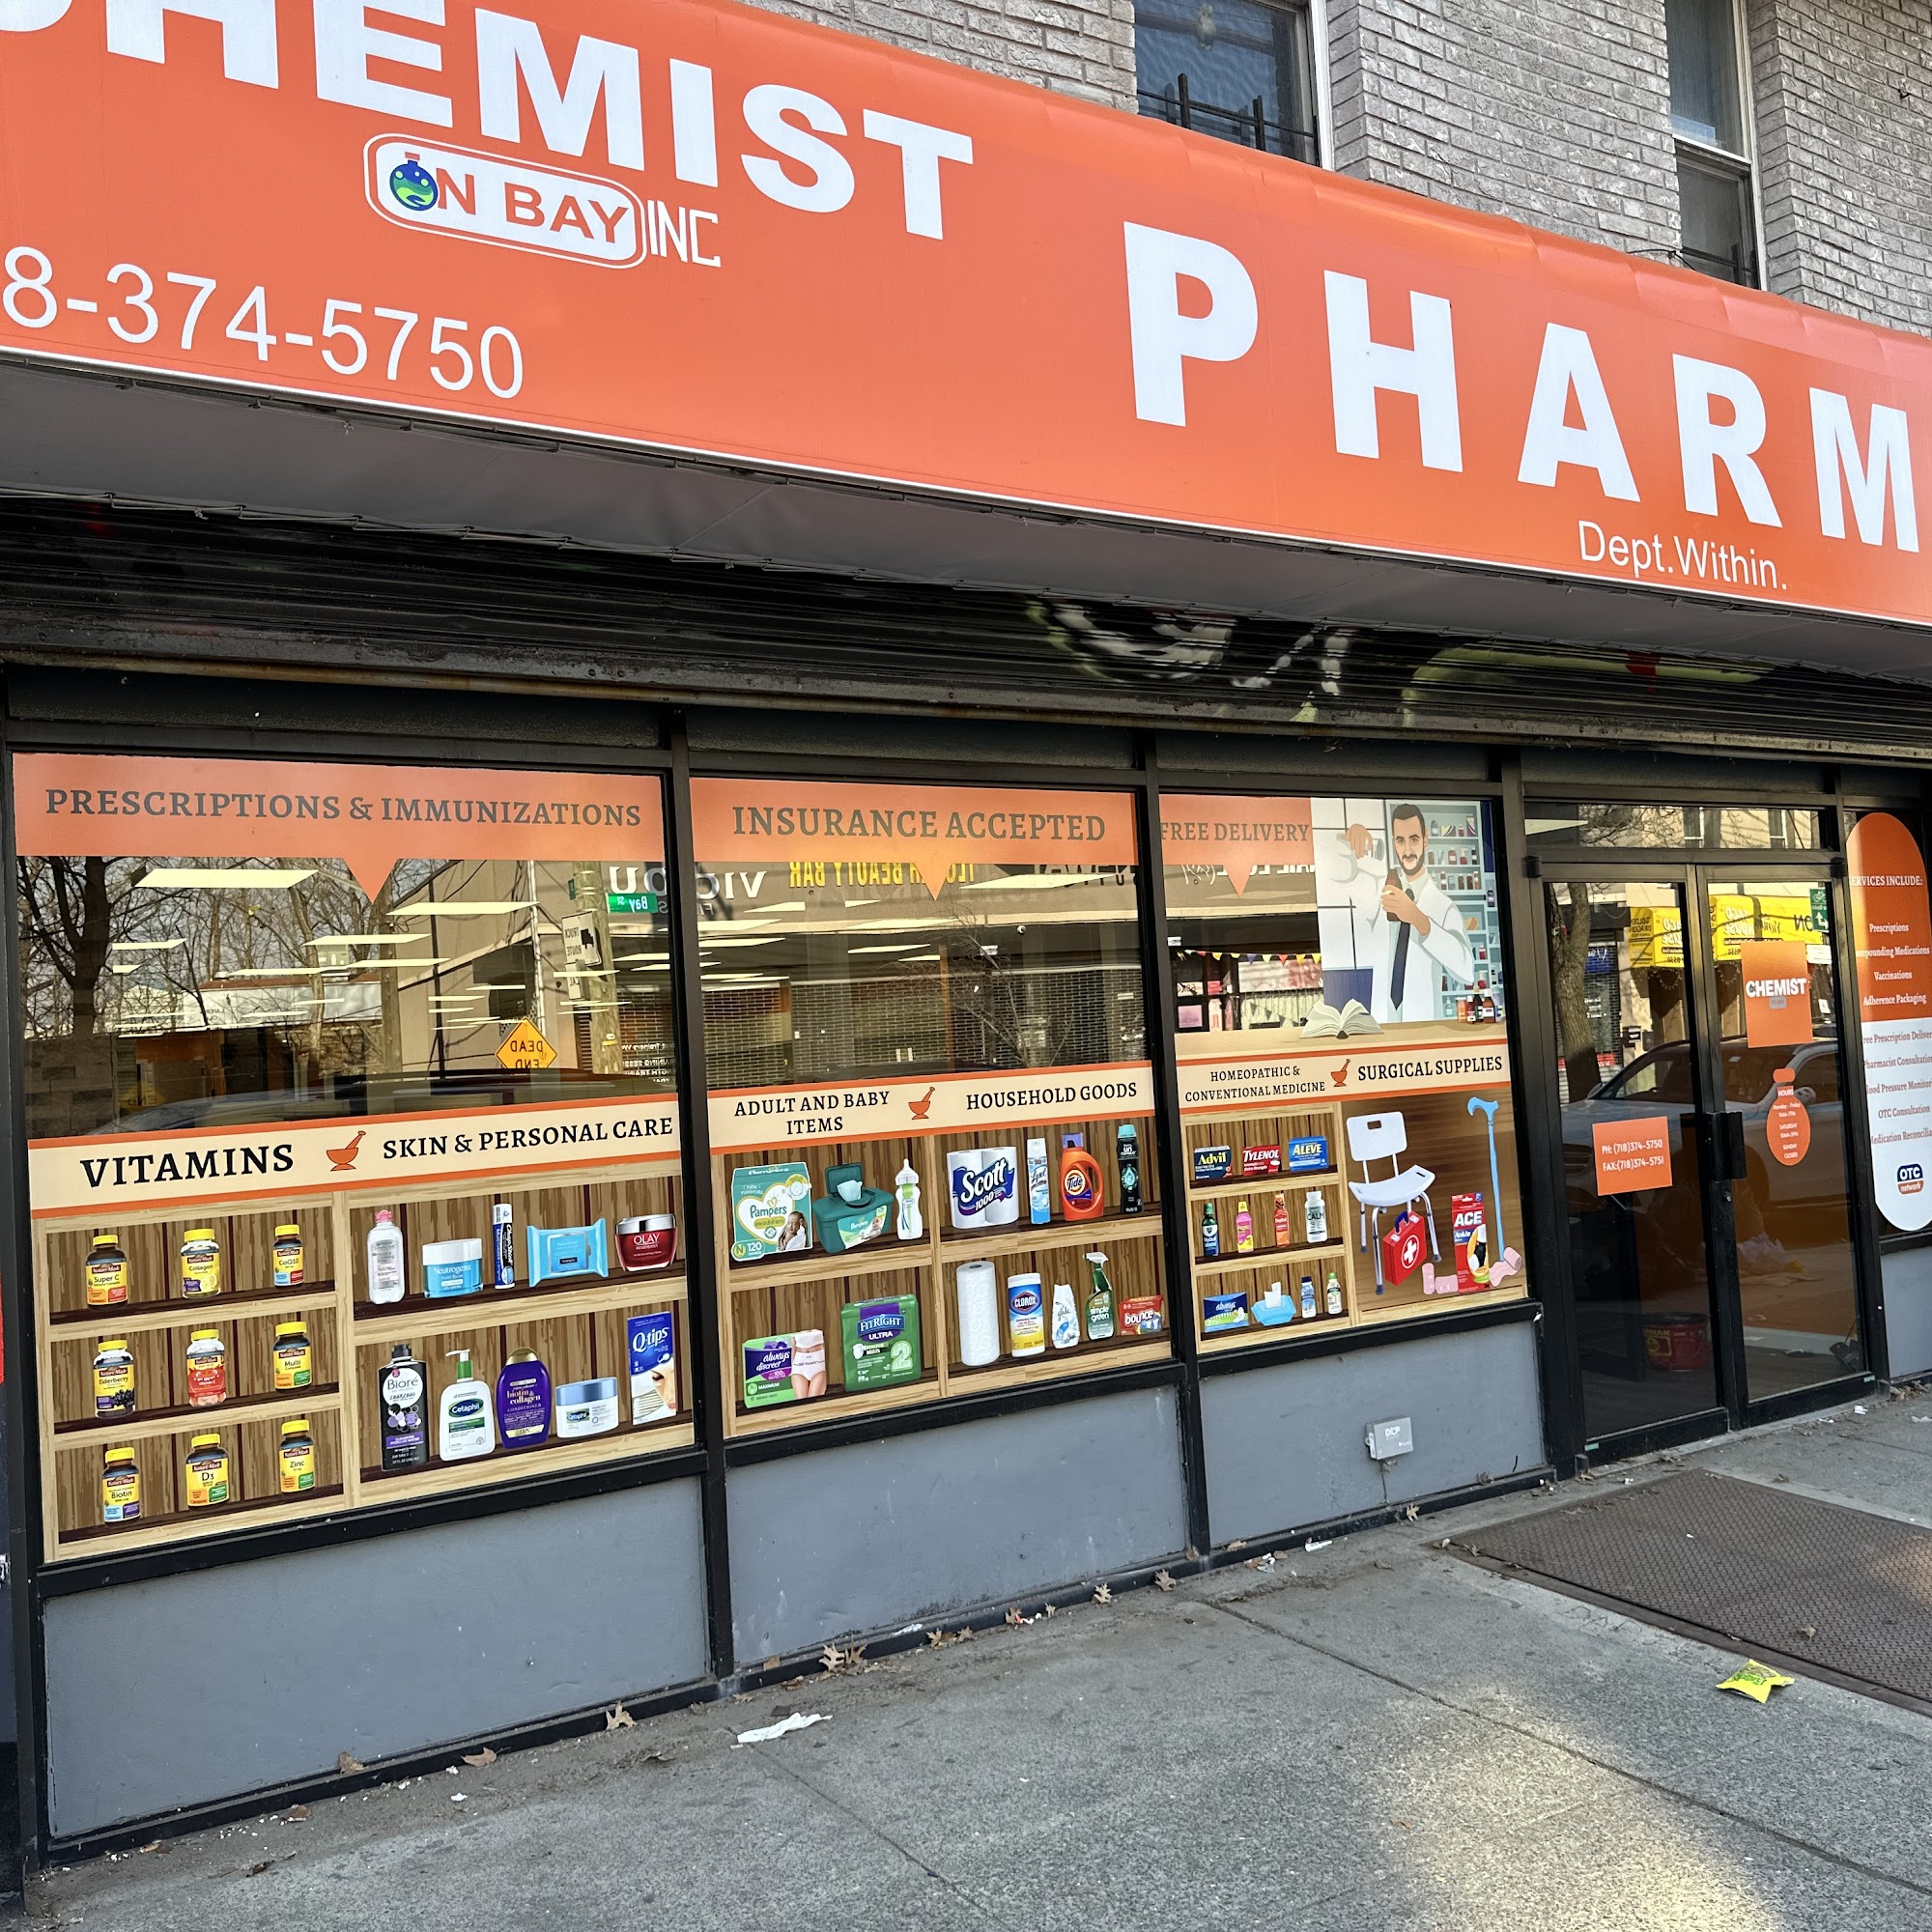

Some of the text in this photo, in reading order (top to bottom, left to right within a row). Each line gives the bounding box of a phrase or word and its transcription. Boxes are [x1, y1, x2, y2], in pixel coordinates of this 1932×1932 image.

[0, 0, 974, 240] HEMIST
[504, 182, 630, 243] BAY
[646, 199, 722, 268] INC
[3, 246, 524, 399] 8-374-5750
[1123, 221, 1918, 554] PHARM
[45, 789, 641, 827] PRESCRIPTIONS & IMMUNIZATIONS
[732, 807, 1106, 841] INSURANCE ACCEPTED
[1160, 822, 1310, 842] FREE DELIVERY
[1869, 923, 1909, 934] Prescriptions
[1855, 945, 1930, 960] ompounding Medications
[1874, 970, 1913, 980] Vaccinations
[1746, 978, 1807, 998] CHEMIST
[1863, 993, 1927, 1007] Adherence Packaging
[1874, 1032, 1911, 1044] Prescription
[1210, 1065, 1301, 1083] HOMEOPATHIC &
[1357, 1056, 1503, 1082] SURGICAL SUPPLIES
[1185, 1081, 1325, 1103] CONVENTIONAL MEDICINE
[1866, 1084, 1880, 1094] lood
[1881, 1083, 1907, 1094] Pressure
[966, 1082, 1138, 1111] HOUSEHOLD GOODS
[734, 1091, 891, 1118] ADULT AND BABY
[1878, 1104, 1930, 1119] OTC Consultation
[785, 1117, 844, 1136] ITEMS
[383, 1117, 673, 1159] SKIN & PERSONAL CARE
[1243, 1150, 1280, 1162] TYLENOL
[1293, 1144, 1322, 1155] ALEVE
[1198, 1151, 1227, 1165] Advil
[80, 1144, 294, 1188] VITAMINS
[960, 1157, 1008, 1204] Scott
[1899, 1168, 1920, 1181] OTC
[1066, 1177, 1083, 1191] Tide
[1900, 1183, 1921, 1193] network
[975, 1192, 994, 1212] 1000
[750, 1205, 787, 1219] Pampers
[1454, 1210, 1483, 1228] ACE
[634, 1234, 660, 1245] OLAY
[747, 1242, 762, 1252] 120
[189, 1264, 213, 1272] Collagen
[433, 1264, 471, 1274] Neutrogena
[94, 1275, 113, 1284] Super
[1014, 1296, 1037, 1308] CLOROX
[1091, 1313, 1110, 1323] green
[1124, 1309, 1153, 1325] bounce
[868, 1331, 894, 1340] ULTRA
[763, 1351, 790, 1363] always
[756, 1361, 781, 1372] discreet
[99, 1377, 128, 1385] Elderberry
[387, 1377, 418, 1391] Bioré
[507, 1390, 528, 1399] biotin
[510, 1395, 541, 1405] collagen
[451, 1402, 480, 1414] Cetaphil
[290, 1460, 305, 1468] Zinc
[111, 1490, 132, 1499] Biotin
